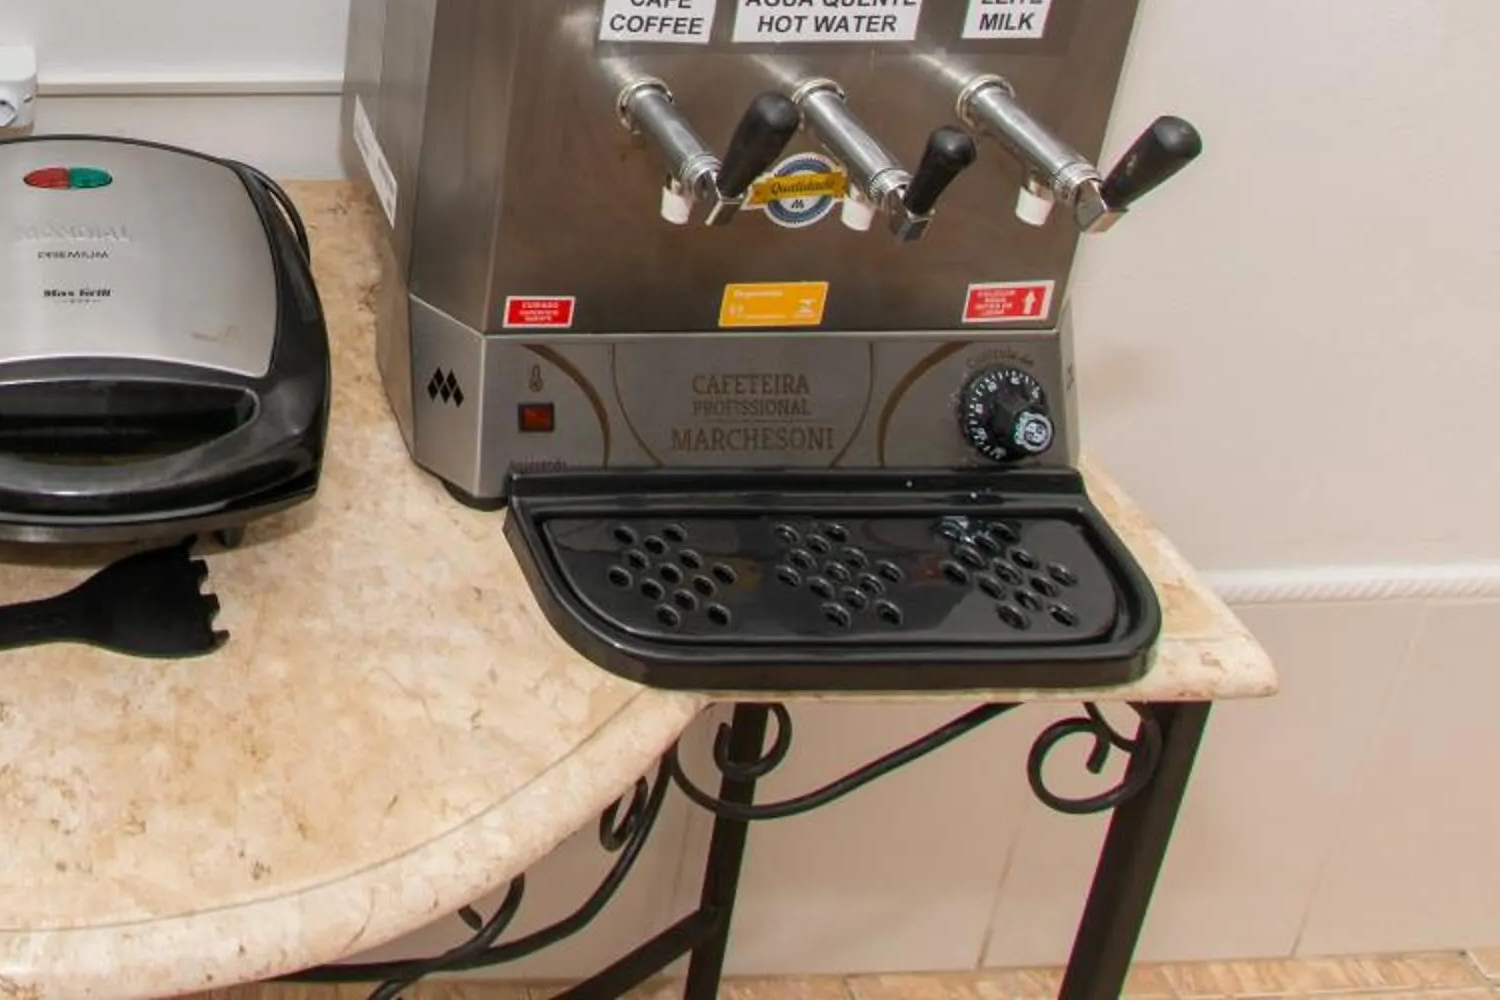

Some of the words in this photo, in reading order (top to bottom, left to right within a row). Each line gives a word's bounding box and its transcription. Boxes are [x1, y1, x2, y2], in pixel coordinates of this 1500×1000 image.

[609, 13, 705, 35] COFFEE
[757, 15, 808, 33] HOT
[814, 15, 898, 33] WATER
[979, 12, 1035, 31] MILK
[692, 373, 810, 395] CAFETEIRA
[672, 427, 834, 450] MARCHESONI
